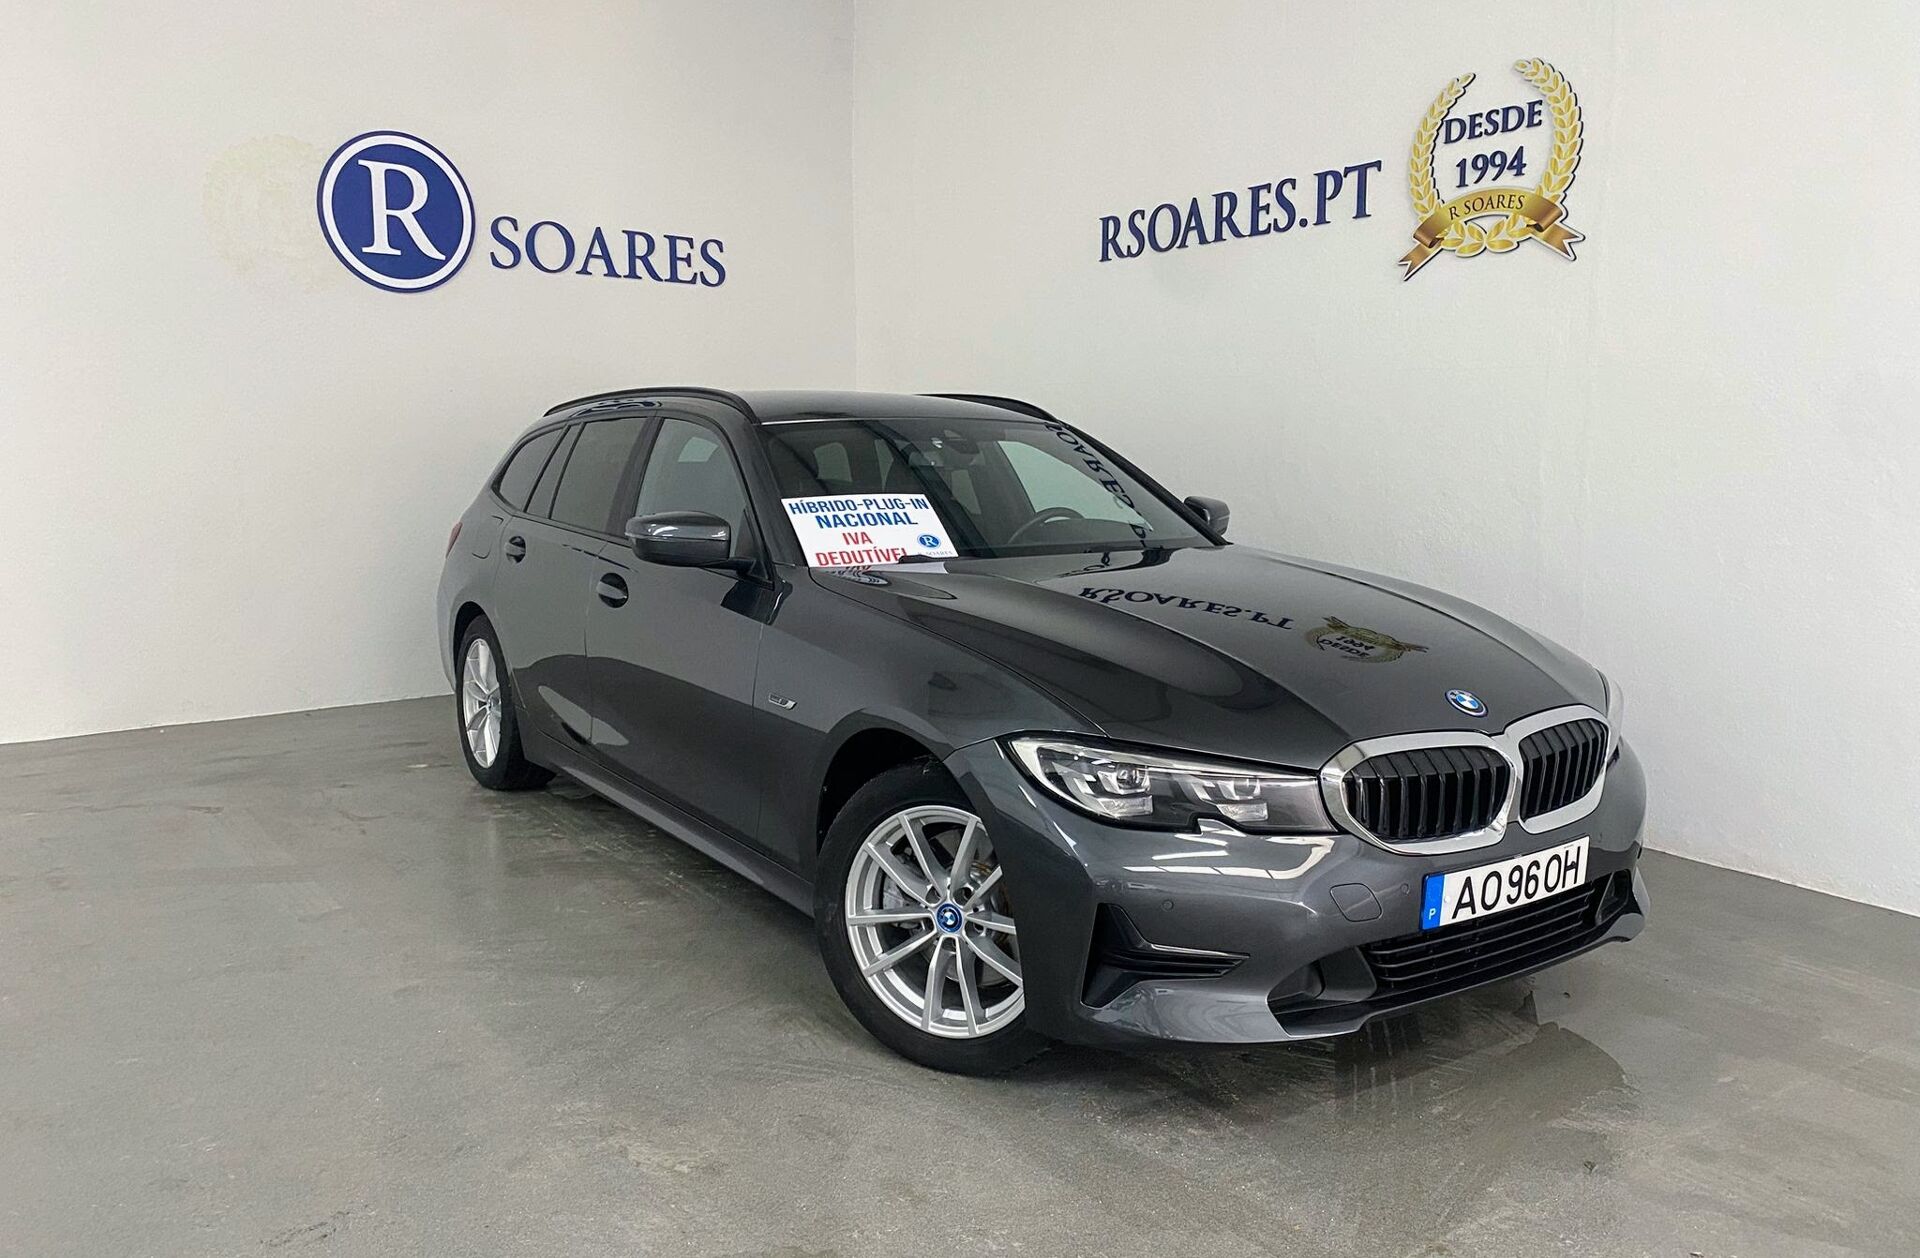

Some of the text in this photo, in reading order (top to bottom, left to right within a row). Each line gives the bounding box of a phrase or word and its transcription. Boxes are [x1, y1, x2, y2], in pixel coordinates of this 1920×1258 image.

[1443, 100, 1543, 145] DESDE
[1456, 145, 1527, 188] 1994
[1098, 160, 1382, 262] RSOARES.PT
[1449, 194, 1525, 220] R SOARES
[358, 159, 727, 288] R SOARES
[788, 498, 930, 515] HÍBRIDO-PLUG-IN
[815, 512, 918, 529] NACIONAL
[842, 531, 873, 545] IVA
[922, 536, 938, 547] R
[1429, 908, 1436, 920] P
